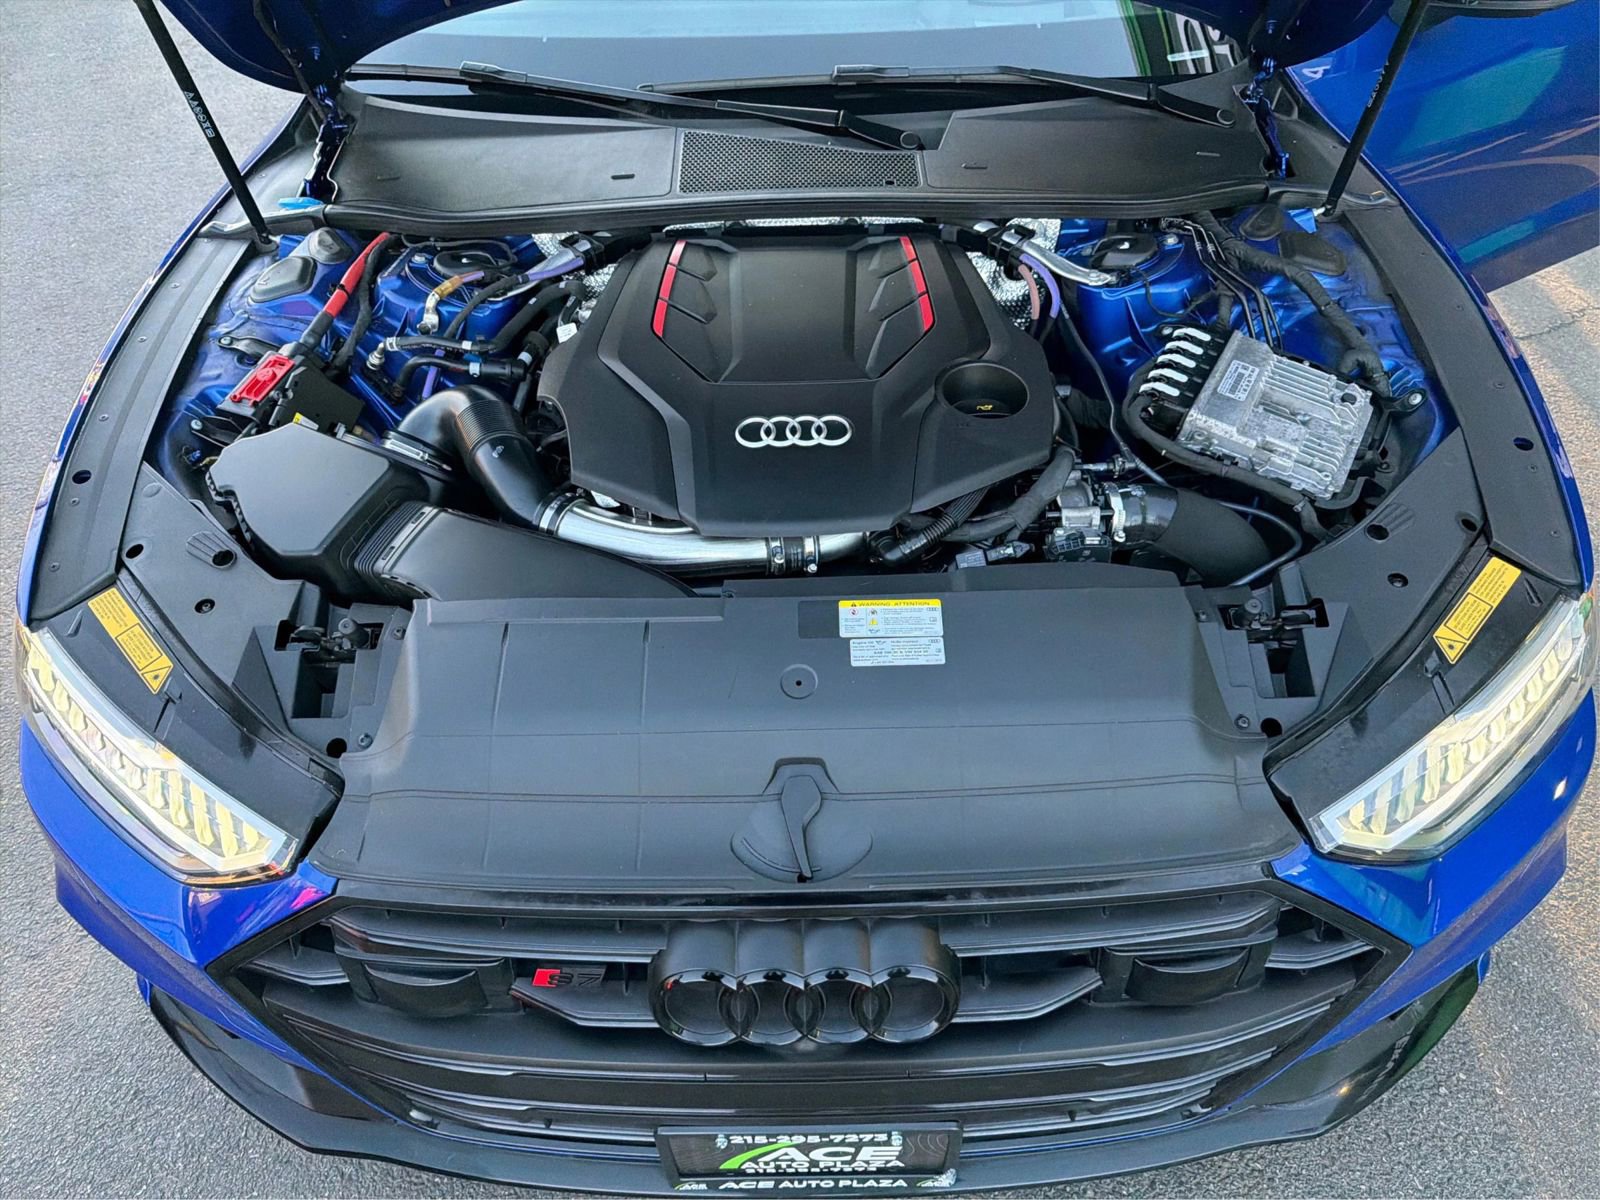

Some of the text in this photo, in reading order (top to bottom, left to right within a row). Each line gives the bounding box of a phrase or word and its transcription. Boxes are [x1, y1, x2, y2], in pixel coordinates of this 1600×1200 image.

[545, 971, 603, 988] S7
[729, 1134, 889, 1144] 215-295-7273
[757, 1146, 902, 1162] ACE
[741, 1160, 905, 1169] AUTO PLAZA
[718, 1179, 908, 1190] ACE AUTO PLAZA
